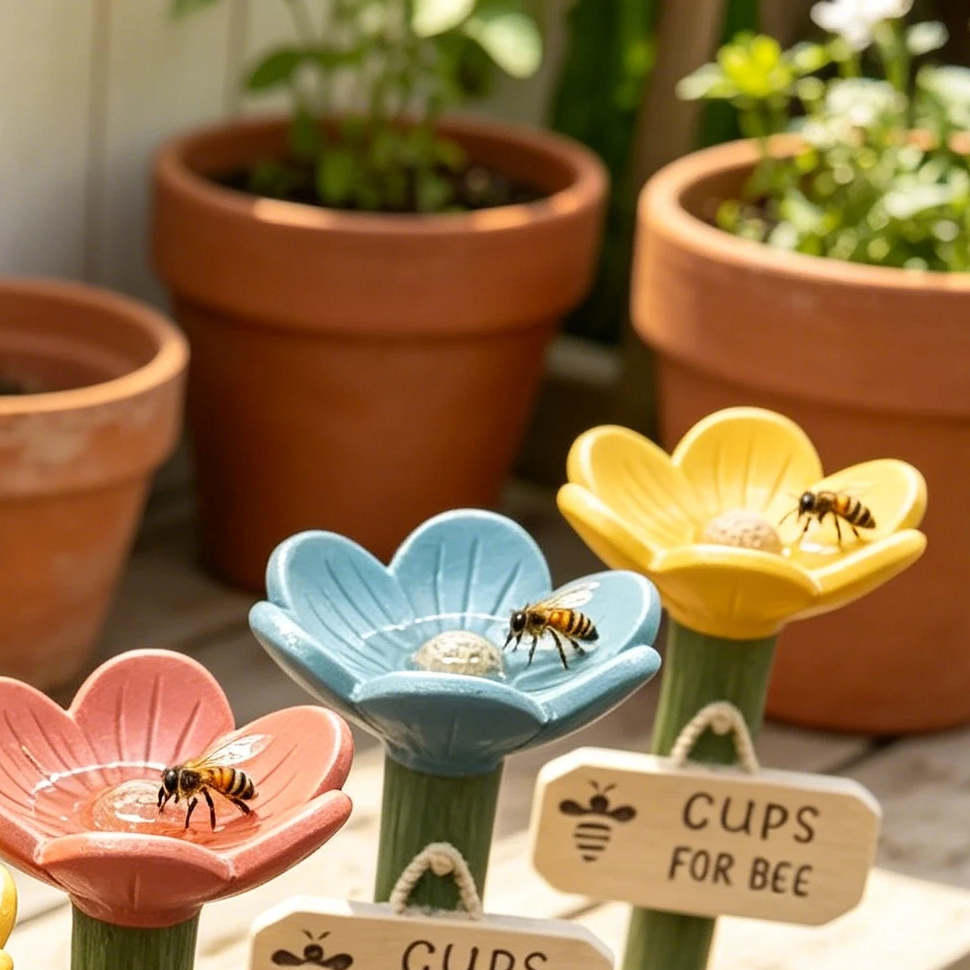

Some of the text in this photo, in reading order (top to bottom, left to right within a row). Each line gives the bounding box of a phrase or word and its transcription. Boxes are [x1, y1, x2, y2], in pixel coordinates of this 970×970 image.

[682, 792, 820, 844] CUPS
[668, 846, 813, 898] FOR BEE
